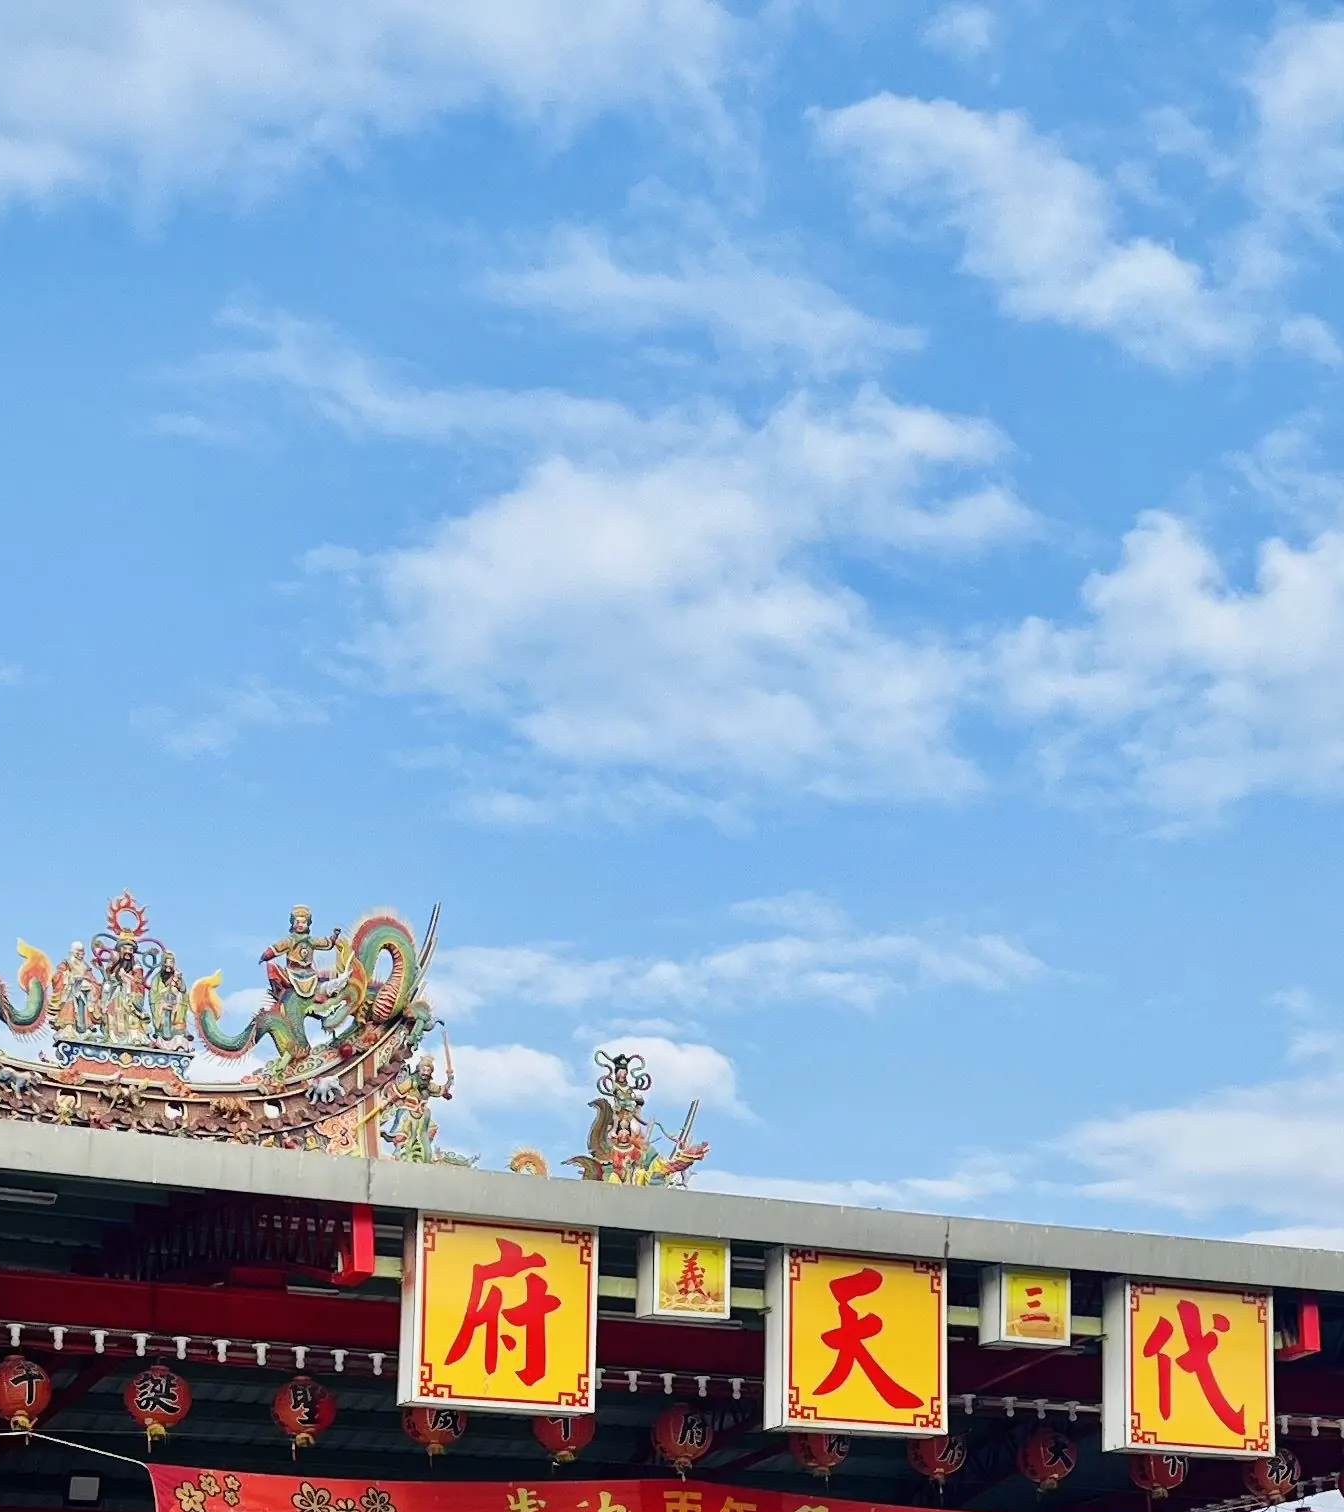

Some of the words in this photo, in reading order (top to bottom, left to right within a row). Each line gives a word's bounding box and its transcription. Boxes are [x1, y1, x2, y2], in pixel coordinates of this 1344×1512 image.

[675, 1250, 708, 1298] 義
[444, 1238, 562, 1388] 府
[1021, 1286, 1049, 1321] 三
[812, 1267, 924, 1409] 天
[1143, 1299, 1245, 1435] 代
[134, 1374, 181, 1414] 誕
[678, 1415, 709, 1446] 府
